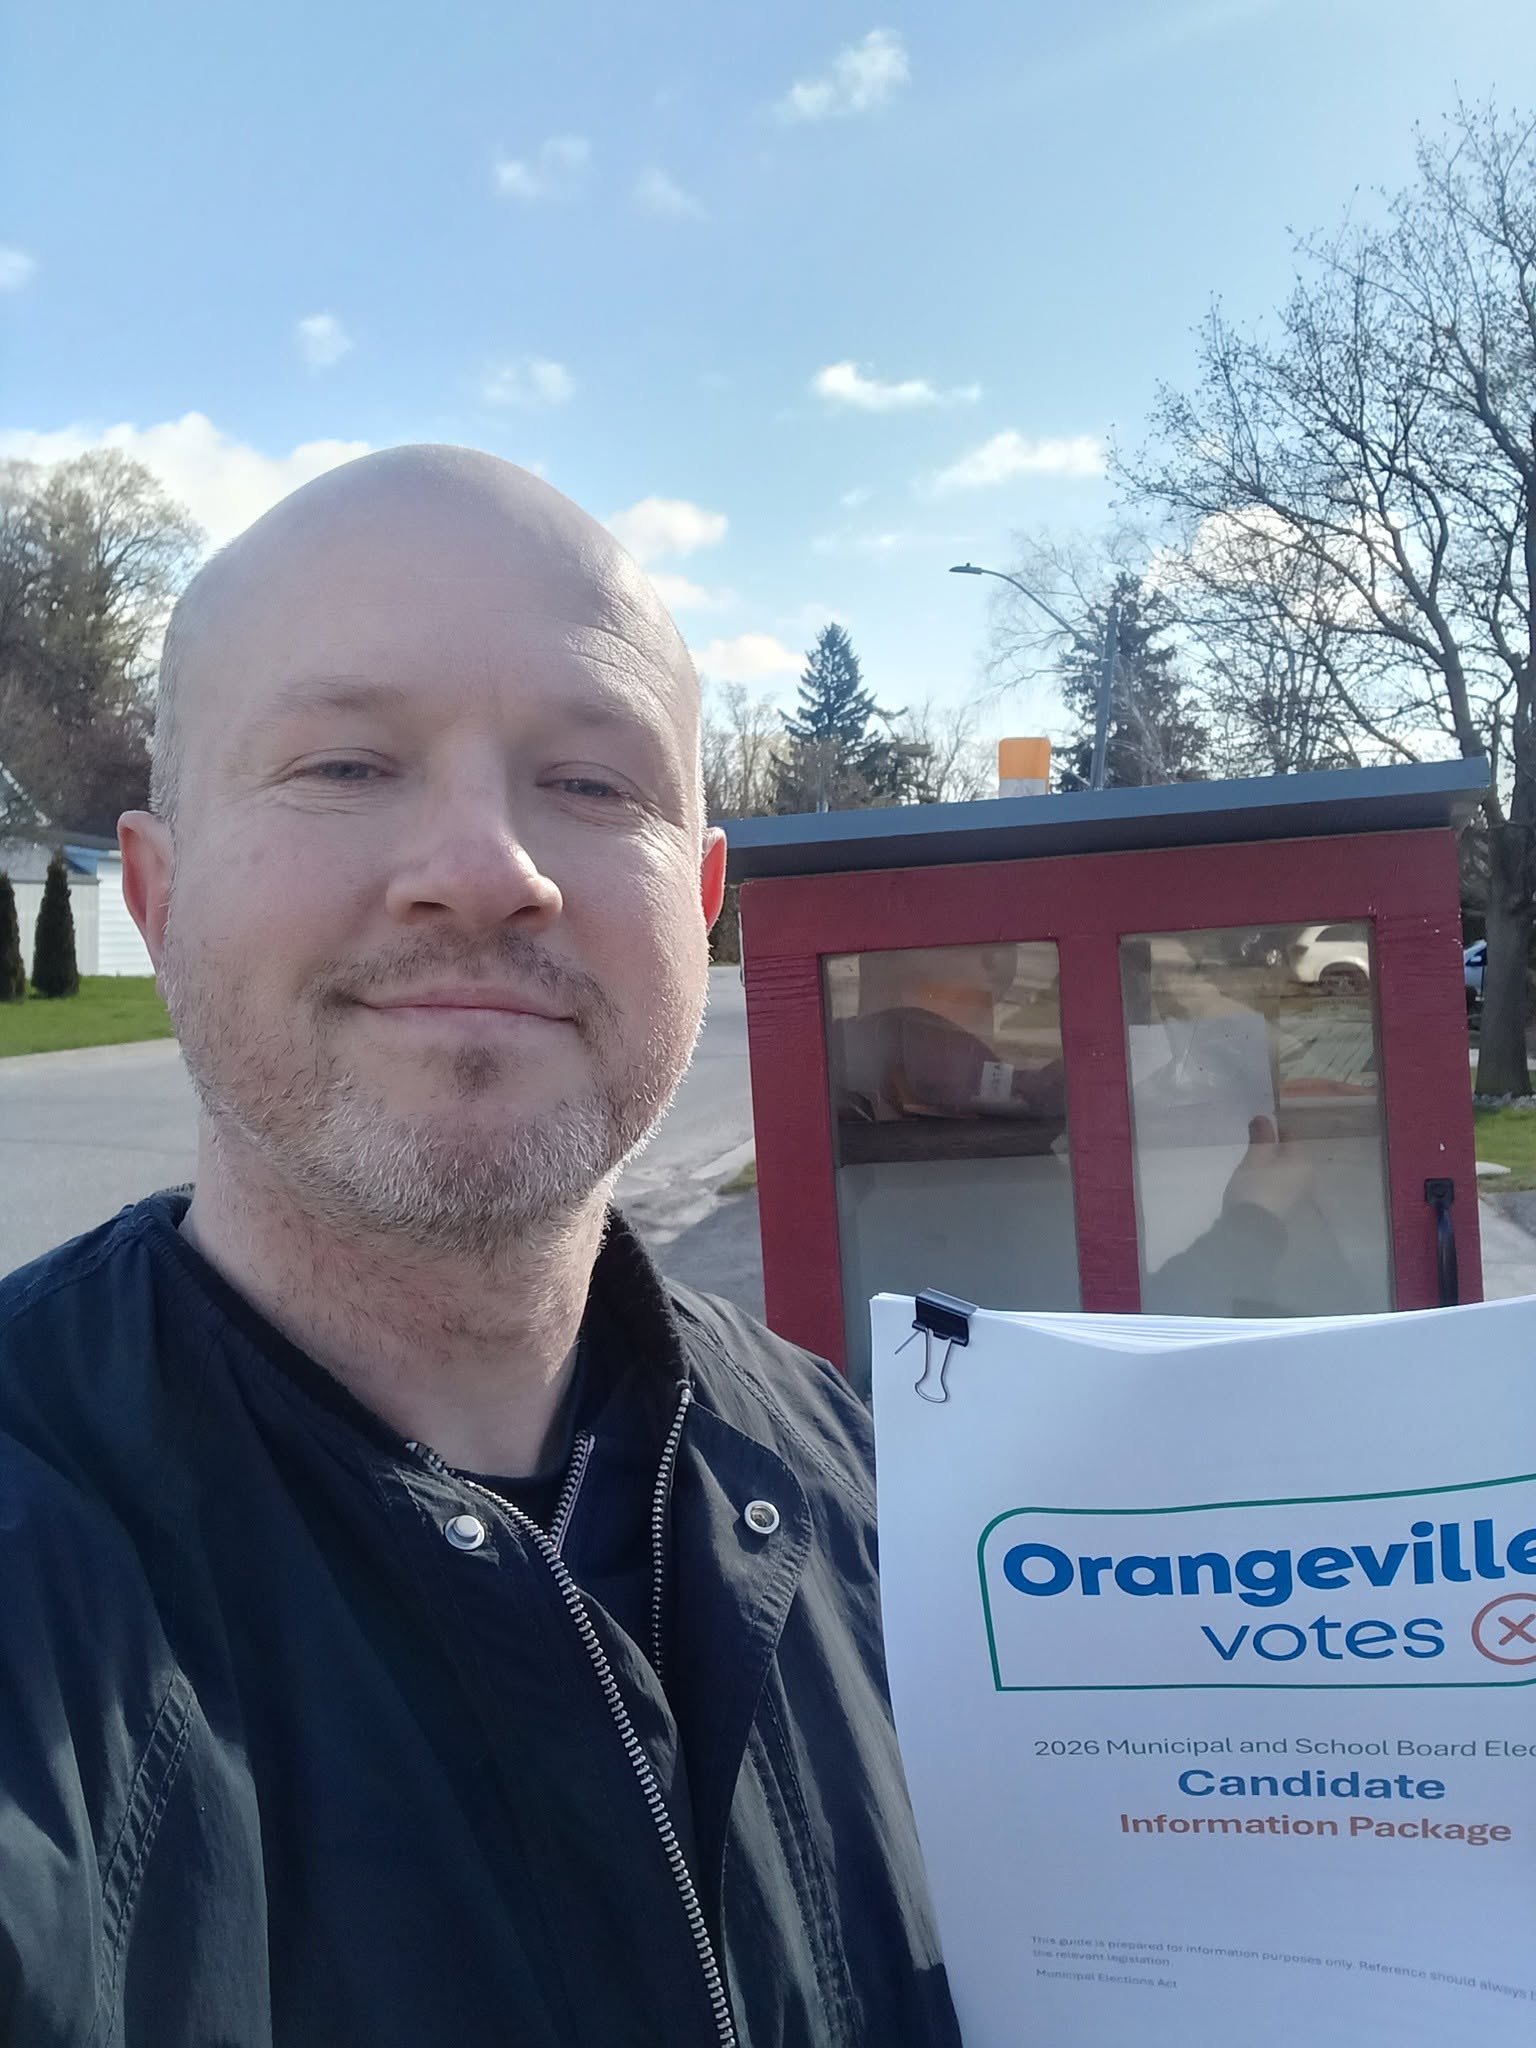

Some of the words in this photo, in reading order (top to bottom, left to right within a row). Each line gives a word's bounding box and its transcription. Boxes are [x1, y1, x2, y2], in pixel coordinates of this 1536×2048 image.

[1003, 1519, 1536, 1607] Orangeville
[1201, 1615, 1445, 1661] votes
[1035, 1740, 1100, 1757] 2026
[1107, 1737, 1232, 1758] Municipal
[1240, 1737, 1288, 1755] and
[1295, 1737, 1390, 1757] School
[1398, 1739, 1476, 1758] Board
[1178, 1768, 1446, 1800] Candidate
[1120, 1813, 1338, 1837] Information
[1349, 1816, 1512, 1847] Package
[1032, 1935, 1056, 1945] This
[1059, 1937, 1092, 1947] guide
[1095, 1939, 1105, 1948] is
[1108, 1941, 1164, 1952] prepared
[1167, 1943, 1183, 1953] for
[1186, 1945, 1260, 1959] information
[1262, 1951, 1322, 1966] purposes
[1359, 1960, 1427, 1980] Reference
[1430, 1970, 1476, 1988] should
[1480, 1980, 1527, 1999] always
[1033, 1949, 1054, 1958] the
[1056, 1950, 1104, 1961] relevant
[1036, 1968, 1095, 1981] Municipal
[1098, 1972, 1155, 1986] Elections
[1158, 1978, 1178, 1988] Act
